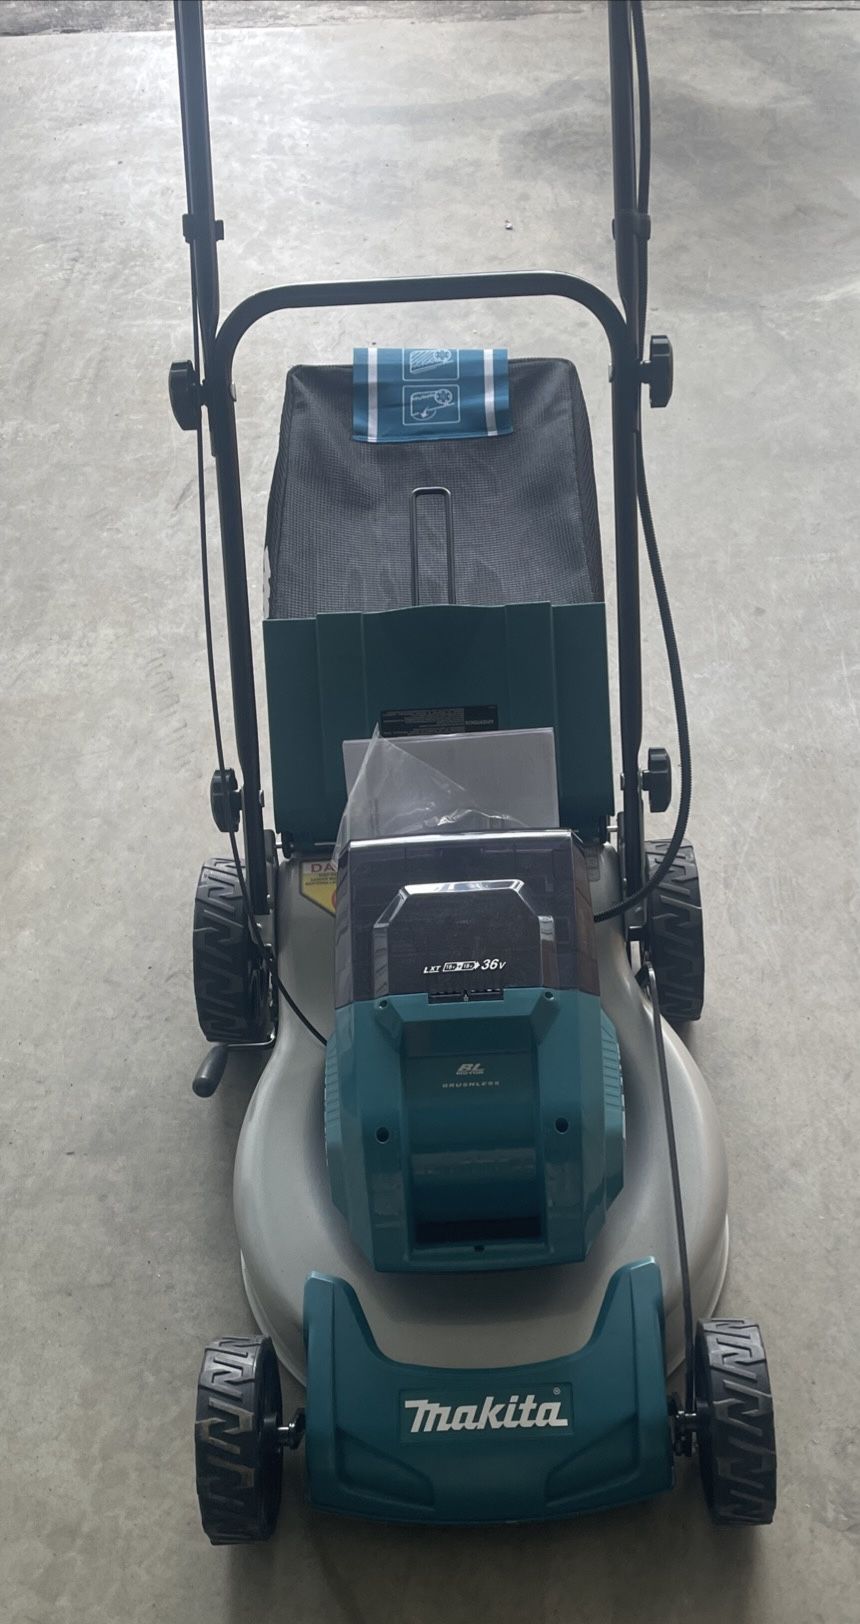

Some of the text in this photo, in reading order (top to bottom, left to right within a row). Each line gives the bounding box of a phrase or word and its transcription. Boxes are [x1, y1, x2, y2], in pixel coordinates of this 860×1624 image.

[423, 965, 441, 974] LXT
[442, 1080, 500, 1089] BRUSHLESS
[404, 1394, 569, 1433] Makita
